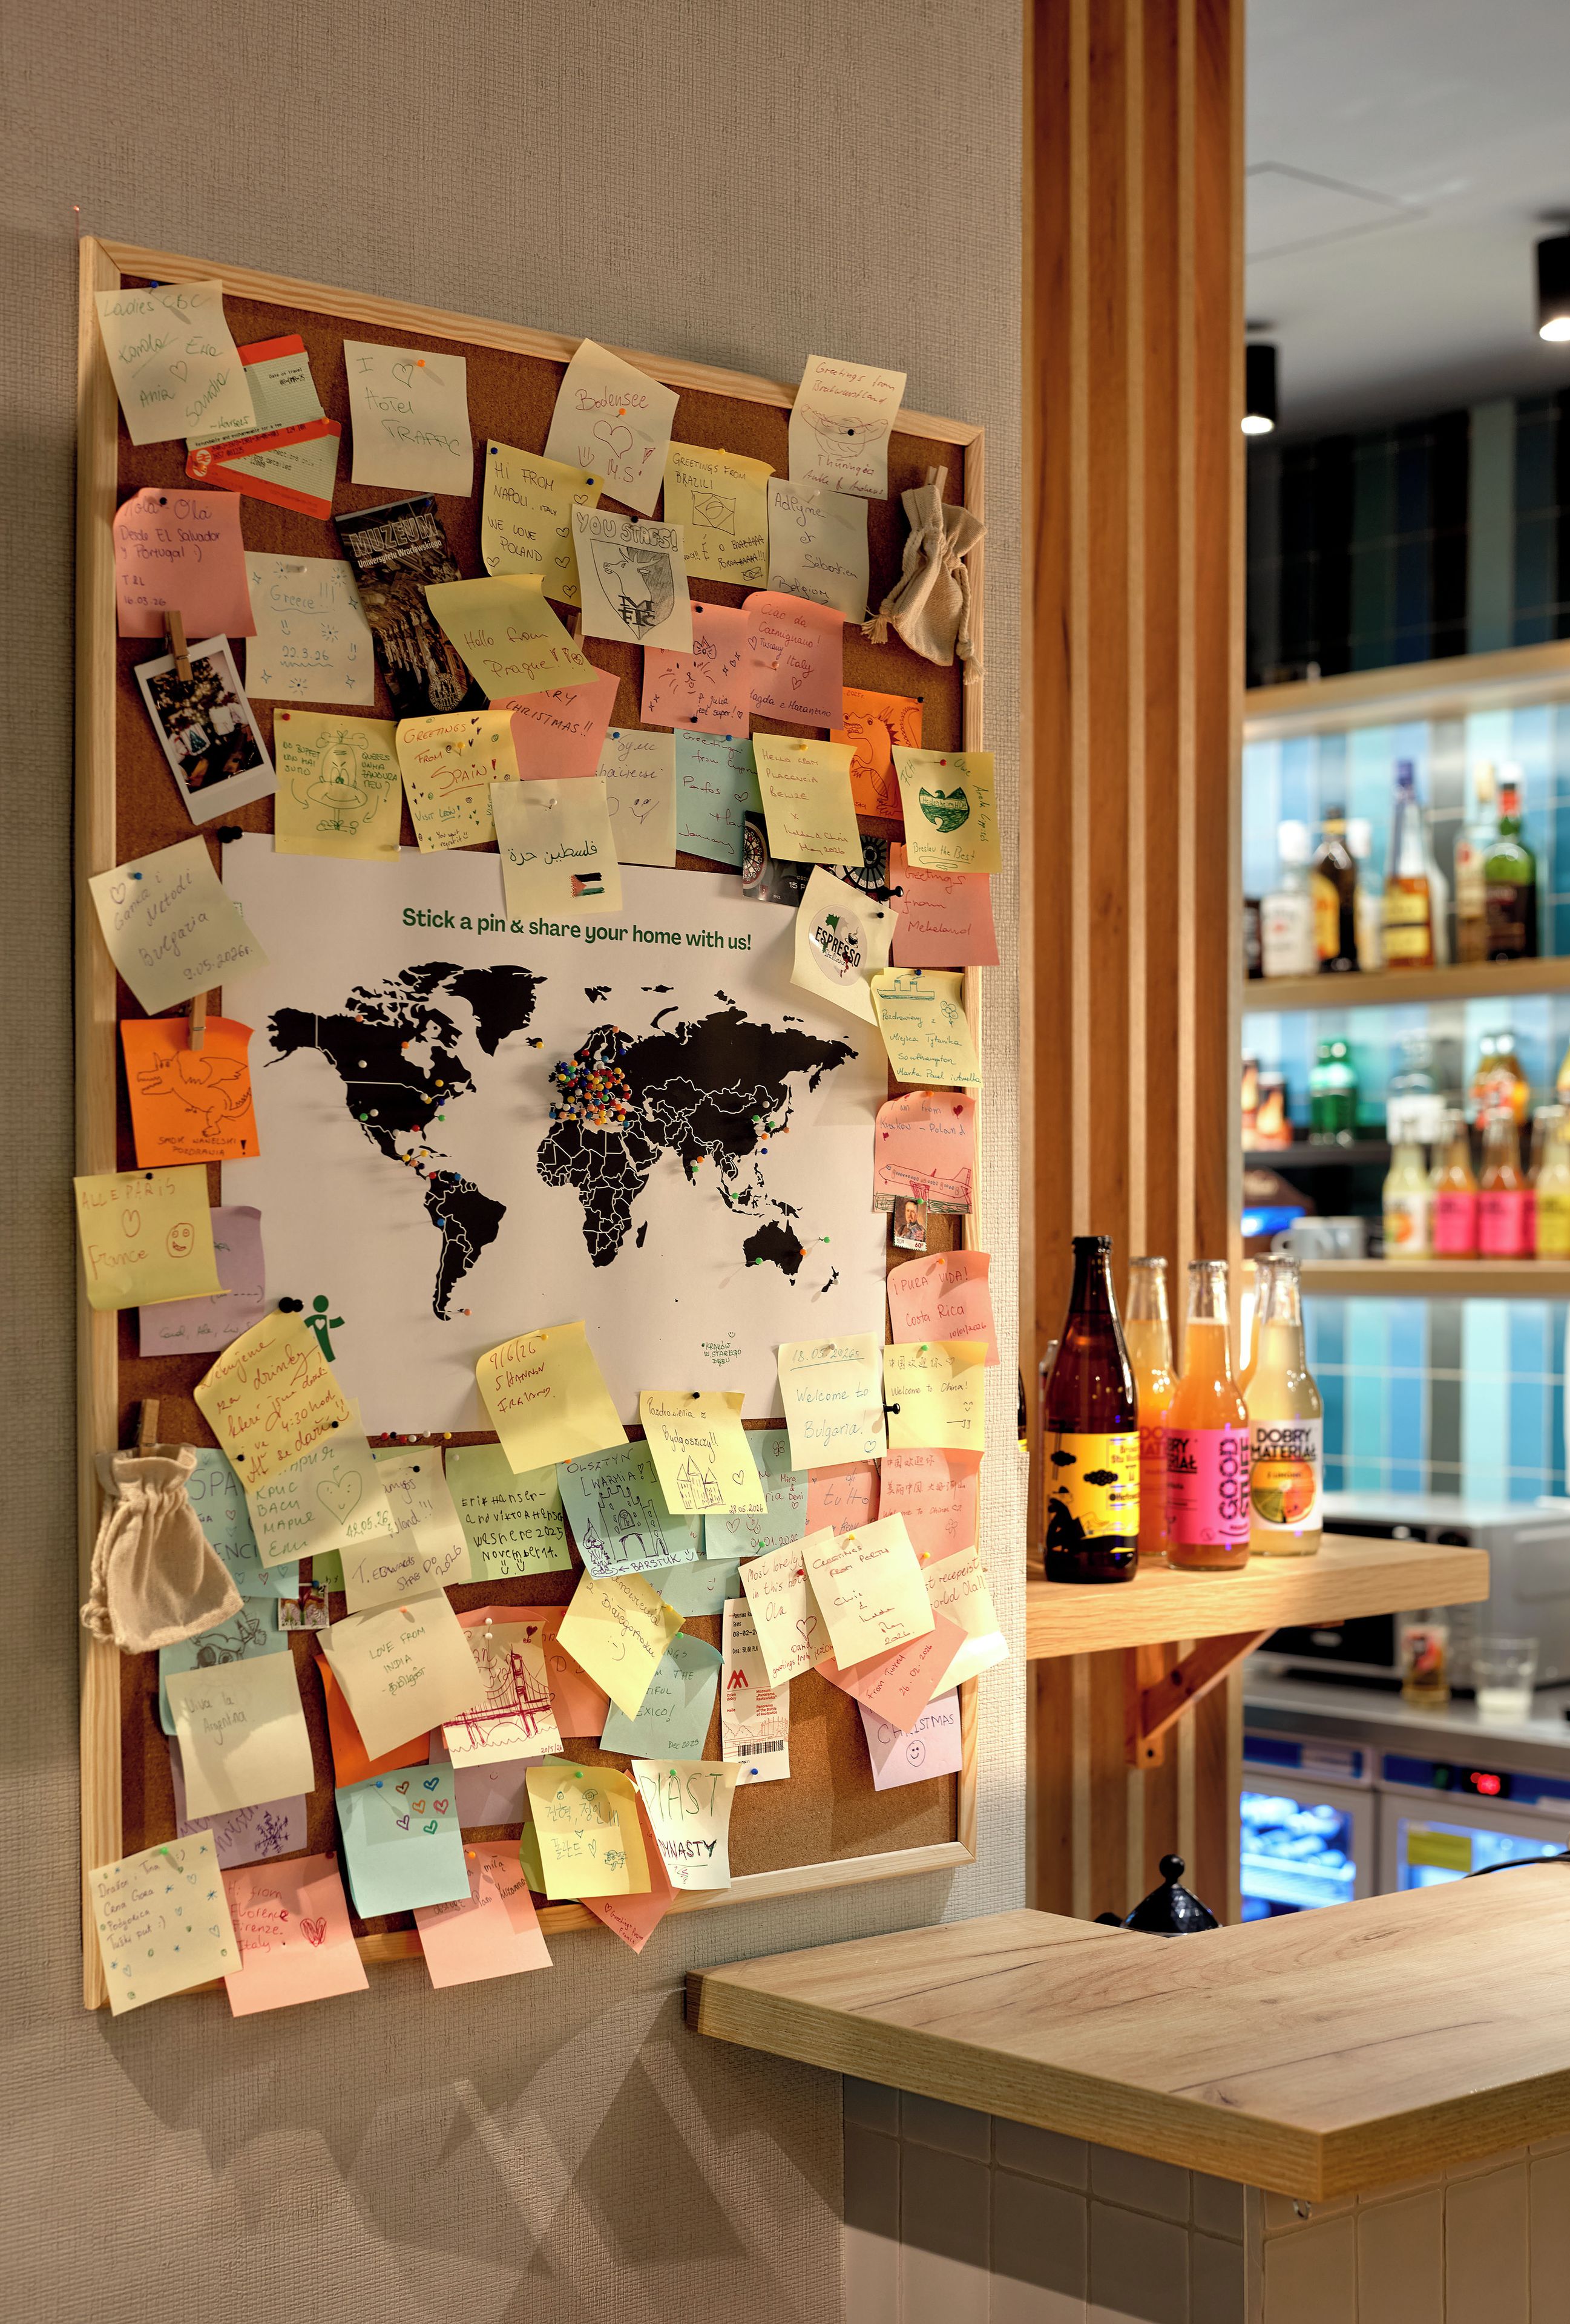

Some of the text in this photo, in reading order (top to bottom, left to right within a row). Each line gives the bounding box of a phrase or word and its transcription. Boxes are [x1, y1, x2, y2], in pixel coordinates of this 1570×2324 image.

[356, 356, 373, 373] I
[815, 362, 895, 391] Greetings from
[575, 386, 649, 412] Bodensee
[672, 453, 746, 480] GREETINGS FROM
[522, 468, 554, 491] FROM
[540, 505, 557, 516] ITALY
[488, 516, 536, 540] WE LOVE
[577, 512, 616, 536] YOU
[177, 528, 220, 542] Salvador
[349, 513, 438, 557] MUZEUM
[133, 545, 185, 562] Portugal
[358, 540, 442, 568] Uniwersytetu Wrocławskiego
[500, 536, 542, 562] POLAND
[761, 604, 807, 628] Ciao da
[464, 629, 494, 650] Hello
[760, 638, 814, 678] Tuscany Italy
[404, 723, 467, 743] GREETINGS
[415, 749, 442, 764] FROM
[762, 749, 790, 762] HELLO
[683, 776, 720, 795] Pafos
[508, 840, 597, 866] فلسطين حرة
[913, 842, 975, 861] Breslau the Best
[402, 908, 752, 950] Stick a pin & share your home with us!
[815, 925, 861, 967] ESPRESSO
[922, 1103, 941, 1115] from
[929, 1124, 965, 1135] Poland
[88, 1244, 149, 1280] France
[941, 1267, 968, 1283] VIDA!
[906, 1304, 965, 1327] Costa Rica
[949, 1324, 987, 1339] 10/01/2026
[490, 1340, 536, 1370] 9/6/26
[706, 1341, 731, 1350] KRAKÓW
[888, 1356, 942, 1370] 中国欢迎你
[496, 1364, 545, 1391] SHANNON
[797, 1382, 869, 1402] Welcome to
[892, 1387, 921, 1396] Welcome
[941, 1382, 967, 1391] China!
[804, 1410, 867, 1446] Bulgaria!
[1257, 1429, 1312, 1442] DOBRY
[567, 1448, 633, 1473] OLSZTYN
[1252, 1444, 1315, 1458] MATERIAŁ
[1220, 1439, 1238, 1519] GOOD
[537, 1526, 563, 1539] 2025
[631, 1556, 681, 1572] BARSTUK
[753, 1582, 783, 1599] in this
[370, 1627, 425, 1659] LOVE FROM
[384, 1655, 412, 1673] INDIA
[773, 1658, 795, 1678] greetings
[674, 1670, 694, 1680] THE
[866, 1680, 884, 1699] From
[682, 1740, 699, 1748] 2025
[638, 1772, 723, 1822] PIAST
[657, 1839, 717, 1860] DYNASTY
[250, 1886, 282, 1900] from
[231, 1904, 289, 1922] Florence
[619, 1928, 636, 1944] France
